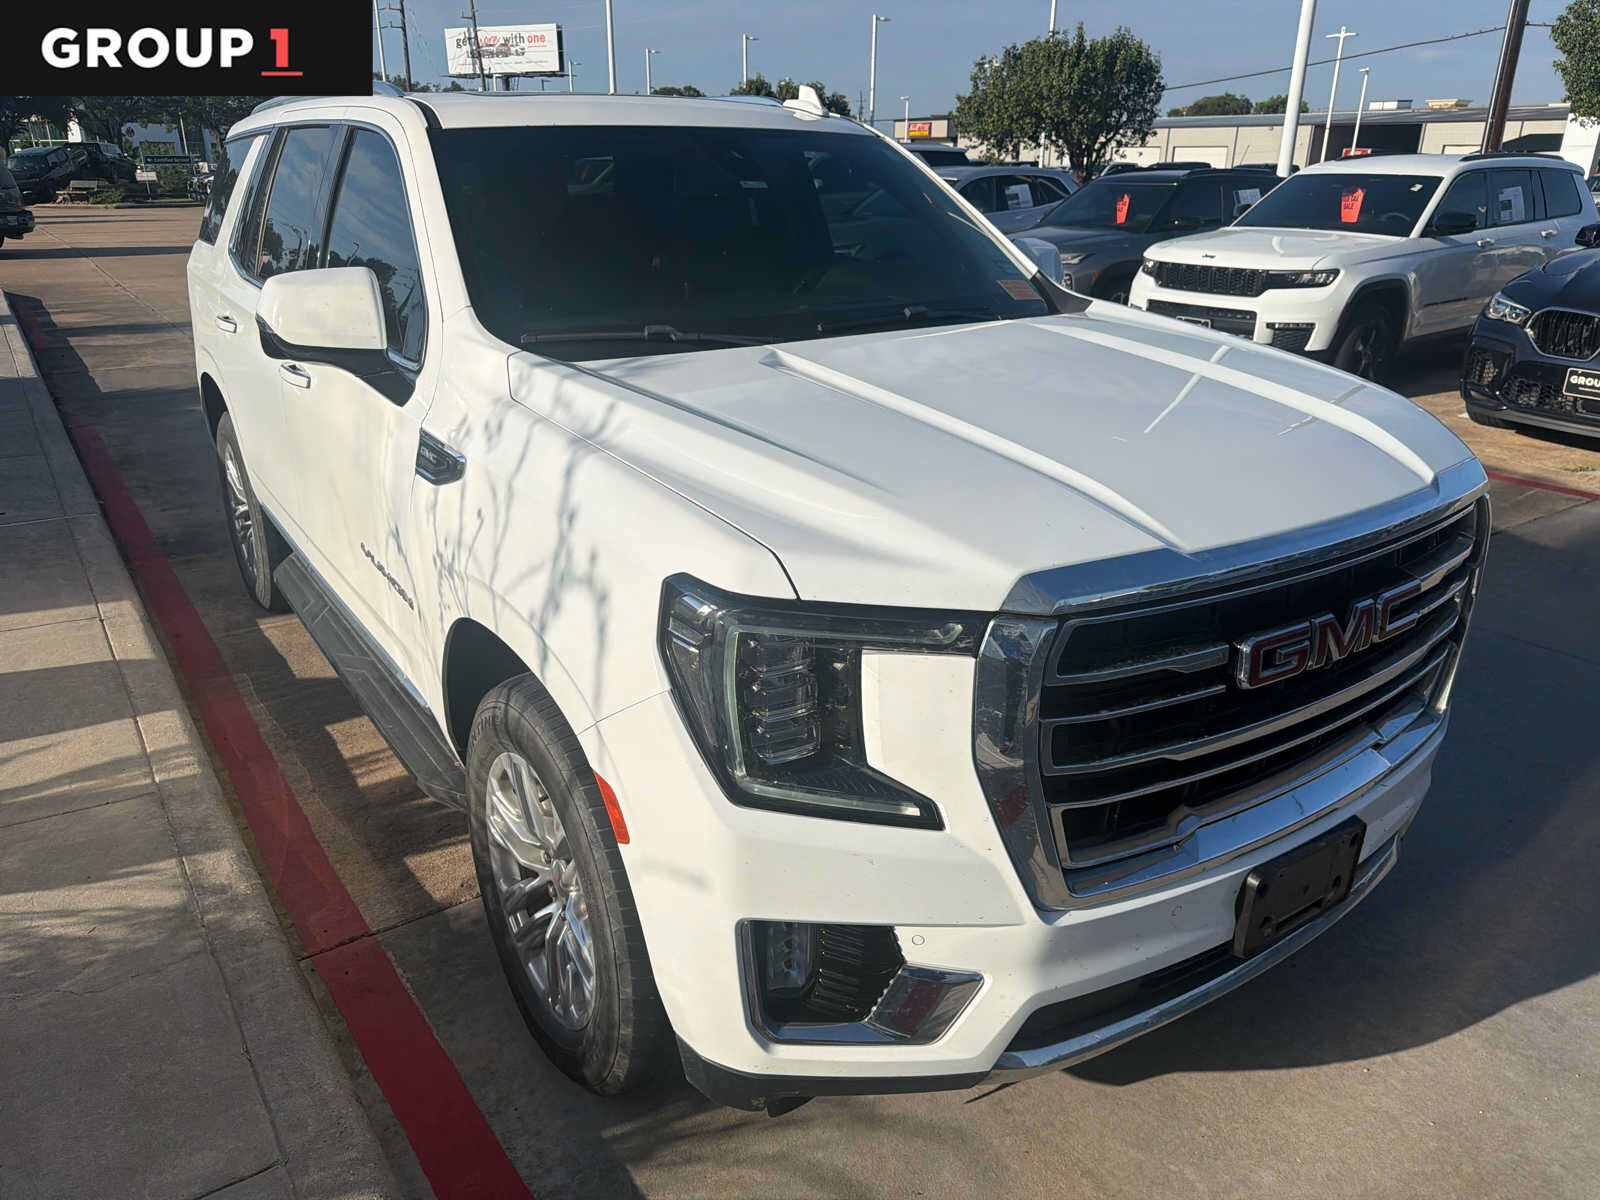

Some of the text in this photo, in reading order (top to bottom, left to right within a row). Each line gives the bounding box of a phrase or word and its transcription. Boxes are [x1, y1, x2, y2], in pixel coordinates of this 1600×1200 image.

[503, 33, 525, 45] with
[527, 33, 545, 44] one
[1236, 579, 1422, 690] GMC
